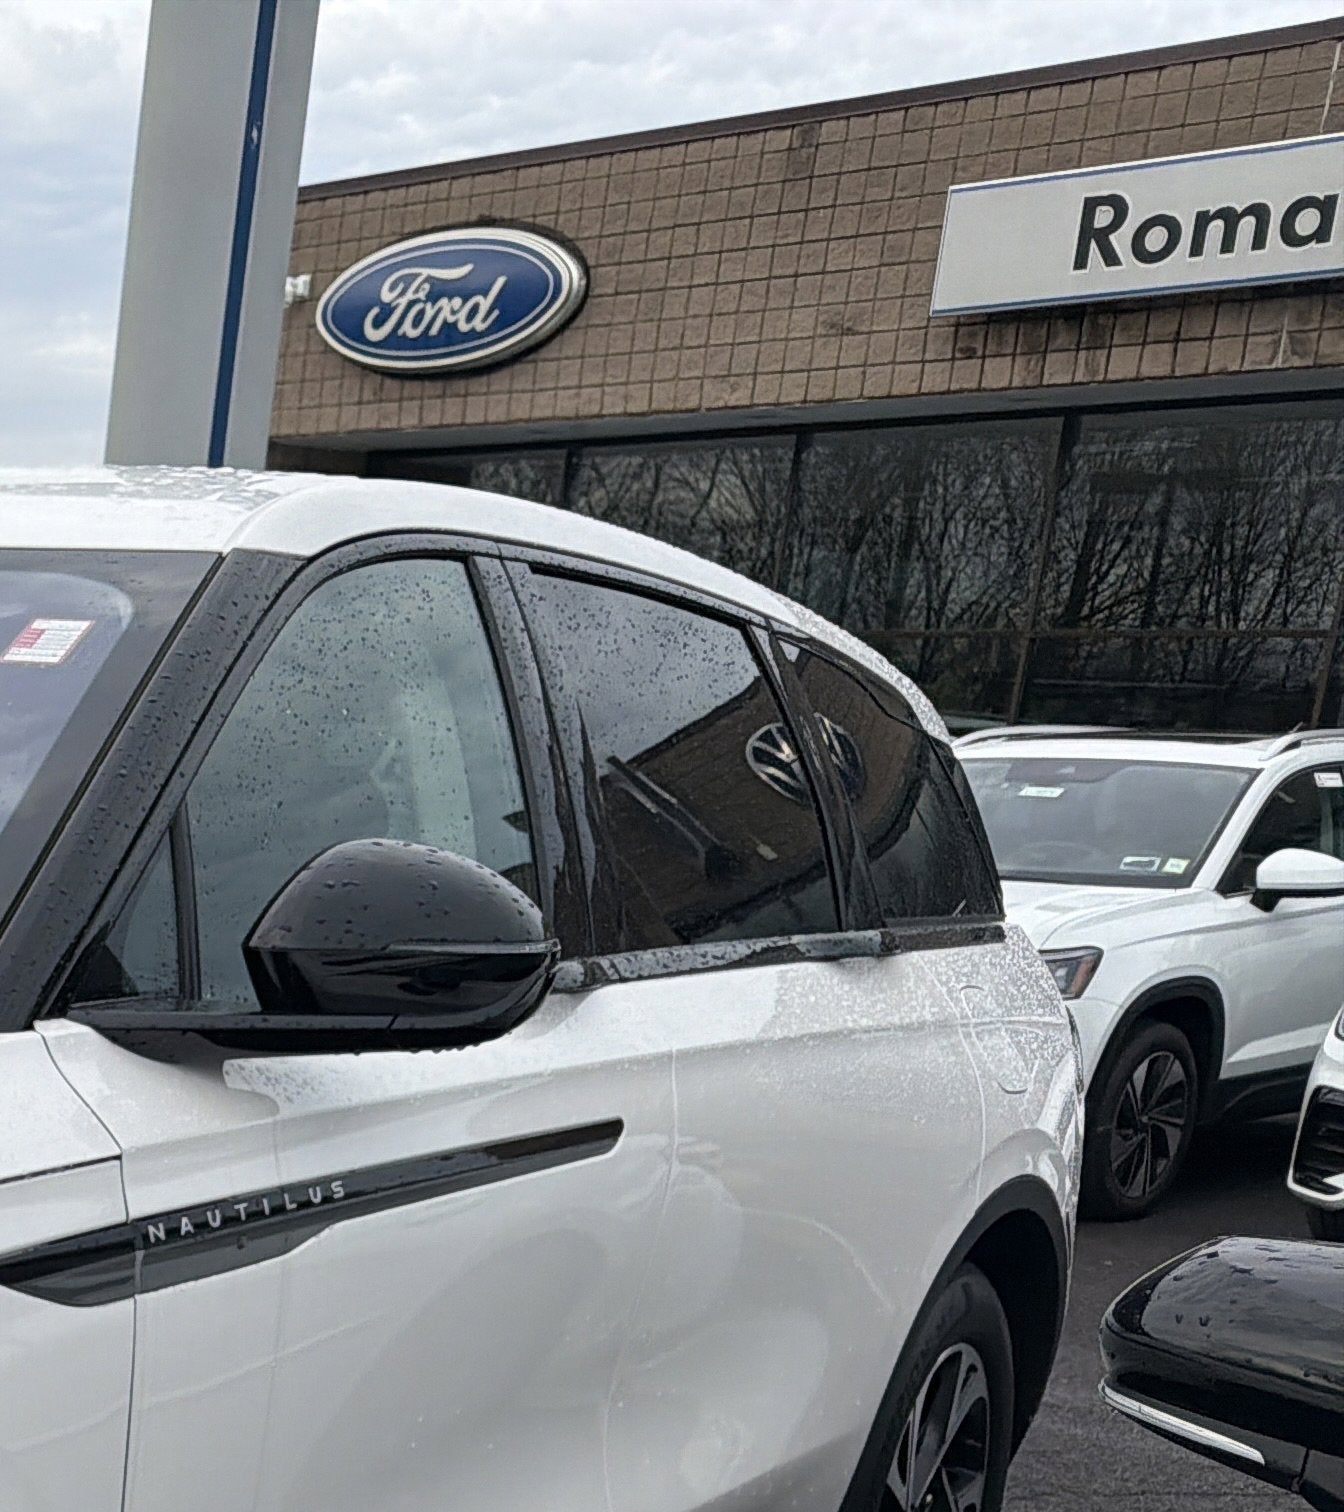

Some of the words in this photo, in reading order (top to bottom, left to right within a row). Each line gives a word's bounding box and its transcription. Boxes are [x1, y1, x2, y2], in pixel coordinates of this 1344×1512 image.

[1072, 193, 1339, 271] Roma
[364, 263, 508, 342] Ford
[147, 1180, 346, 1244] NAUTILUS
